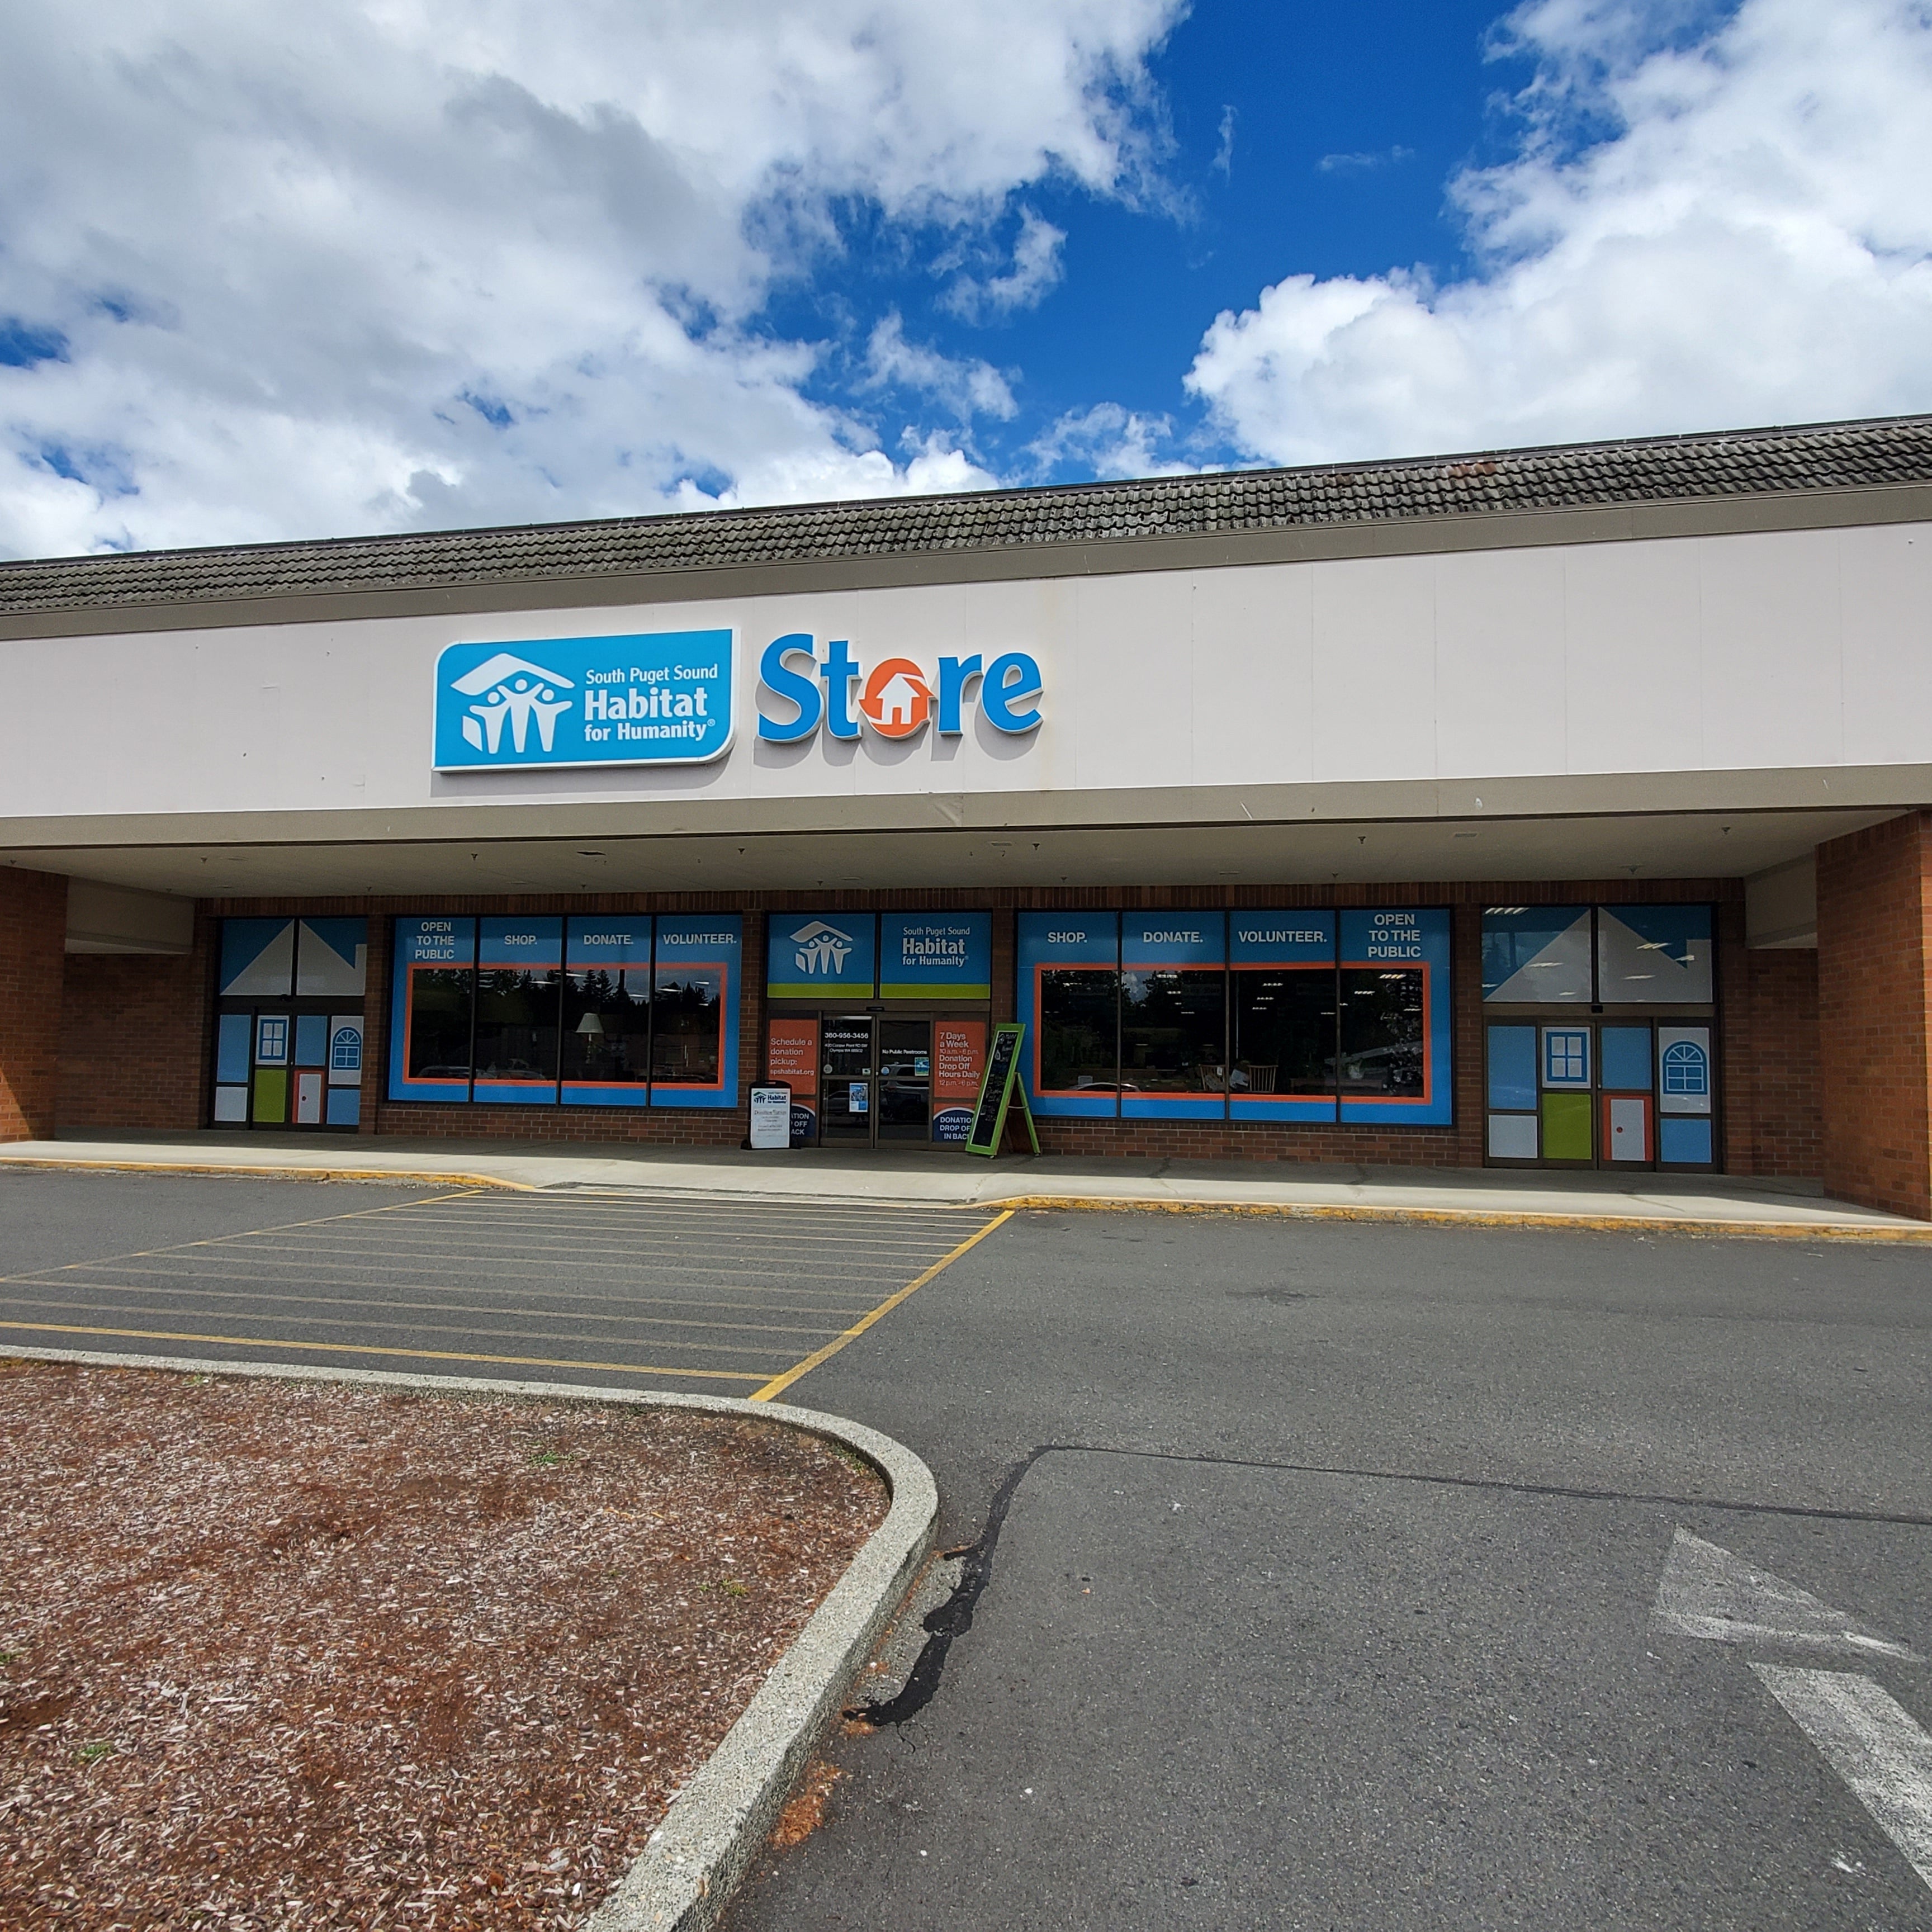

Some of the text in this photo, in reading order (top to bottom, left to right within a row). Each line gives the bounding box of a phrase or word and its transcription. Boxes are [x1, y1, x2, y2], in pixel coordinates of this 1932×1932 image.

[586, 663, 718, 685] South Puget Sound
[759, 632, 1044, 742] Store
[585, 686, 708, 721] Habitat
[585, 724, 611, 741] for
[1374, 914, 1415, 925] OPEN
[421, 922, 451, 931] OPEN
[903, 926, 970, 937] South Puget Sound
[416, 935, 454, 945] TO THE
[504, 935, 537, 945] SHOP.
[584, 935, 633, 945] DONATE.
[663, 934, 737, 944] VOLUNTEER.
[1048, 932, 1087, 943] SHOP.
[1143, 931, 1203, 943] DONATE.
[1238, 931, 1327, 942] VOLUNTEER.
[1368, 930, 1420, 941] TO THE
[903, 937, 965, 954] Habitat
[415, 949, 454, 959] PUBLIC
[1368, 946, 1421, 958] PUBLIC
[902, 955, 916, 965] for
[946, 1032, 966, 1041] Days
[770, 1058, 797, 1066] pickup:
[962, 1071, 981, 1079] Daily
